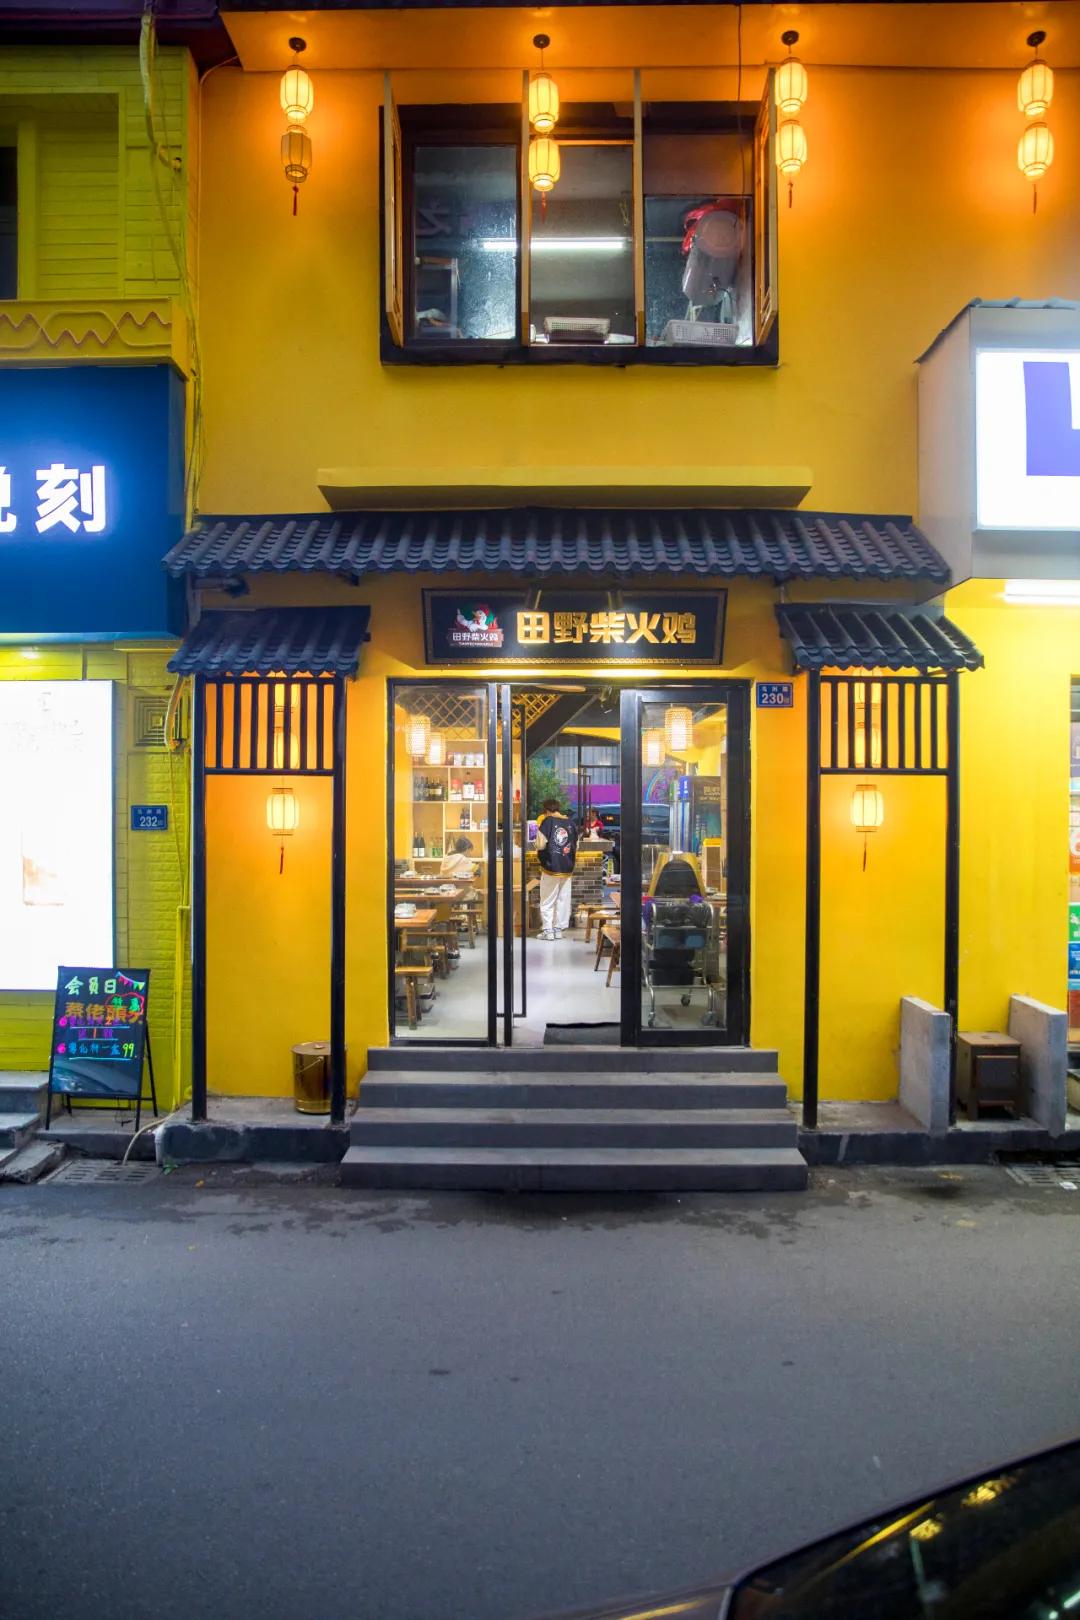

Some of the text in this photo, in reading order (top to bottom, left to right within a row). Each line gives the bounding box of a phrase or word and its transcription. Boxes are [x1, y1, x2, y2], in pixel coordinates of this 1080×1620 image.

[0, 463, 107, 534] 刻
[452, 632, 499, 641] 田野柴火鸡
[516, 610, 697, 645] 田野柴火鸡
